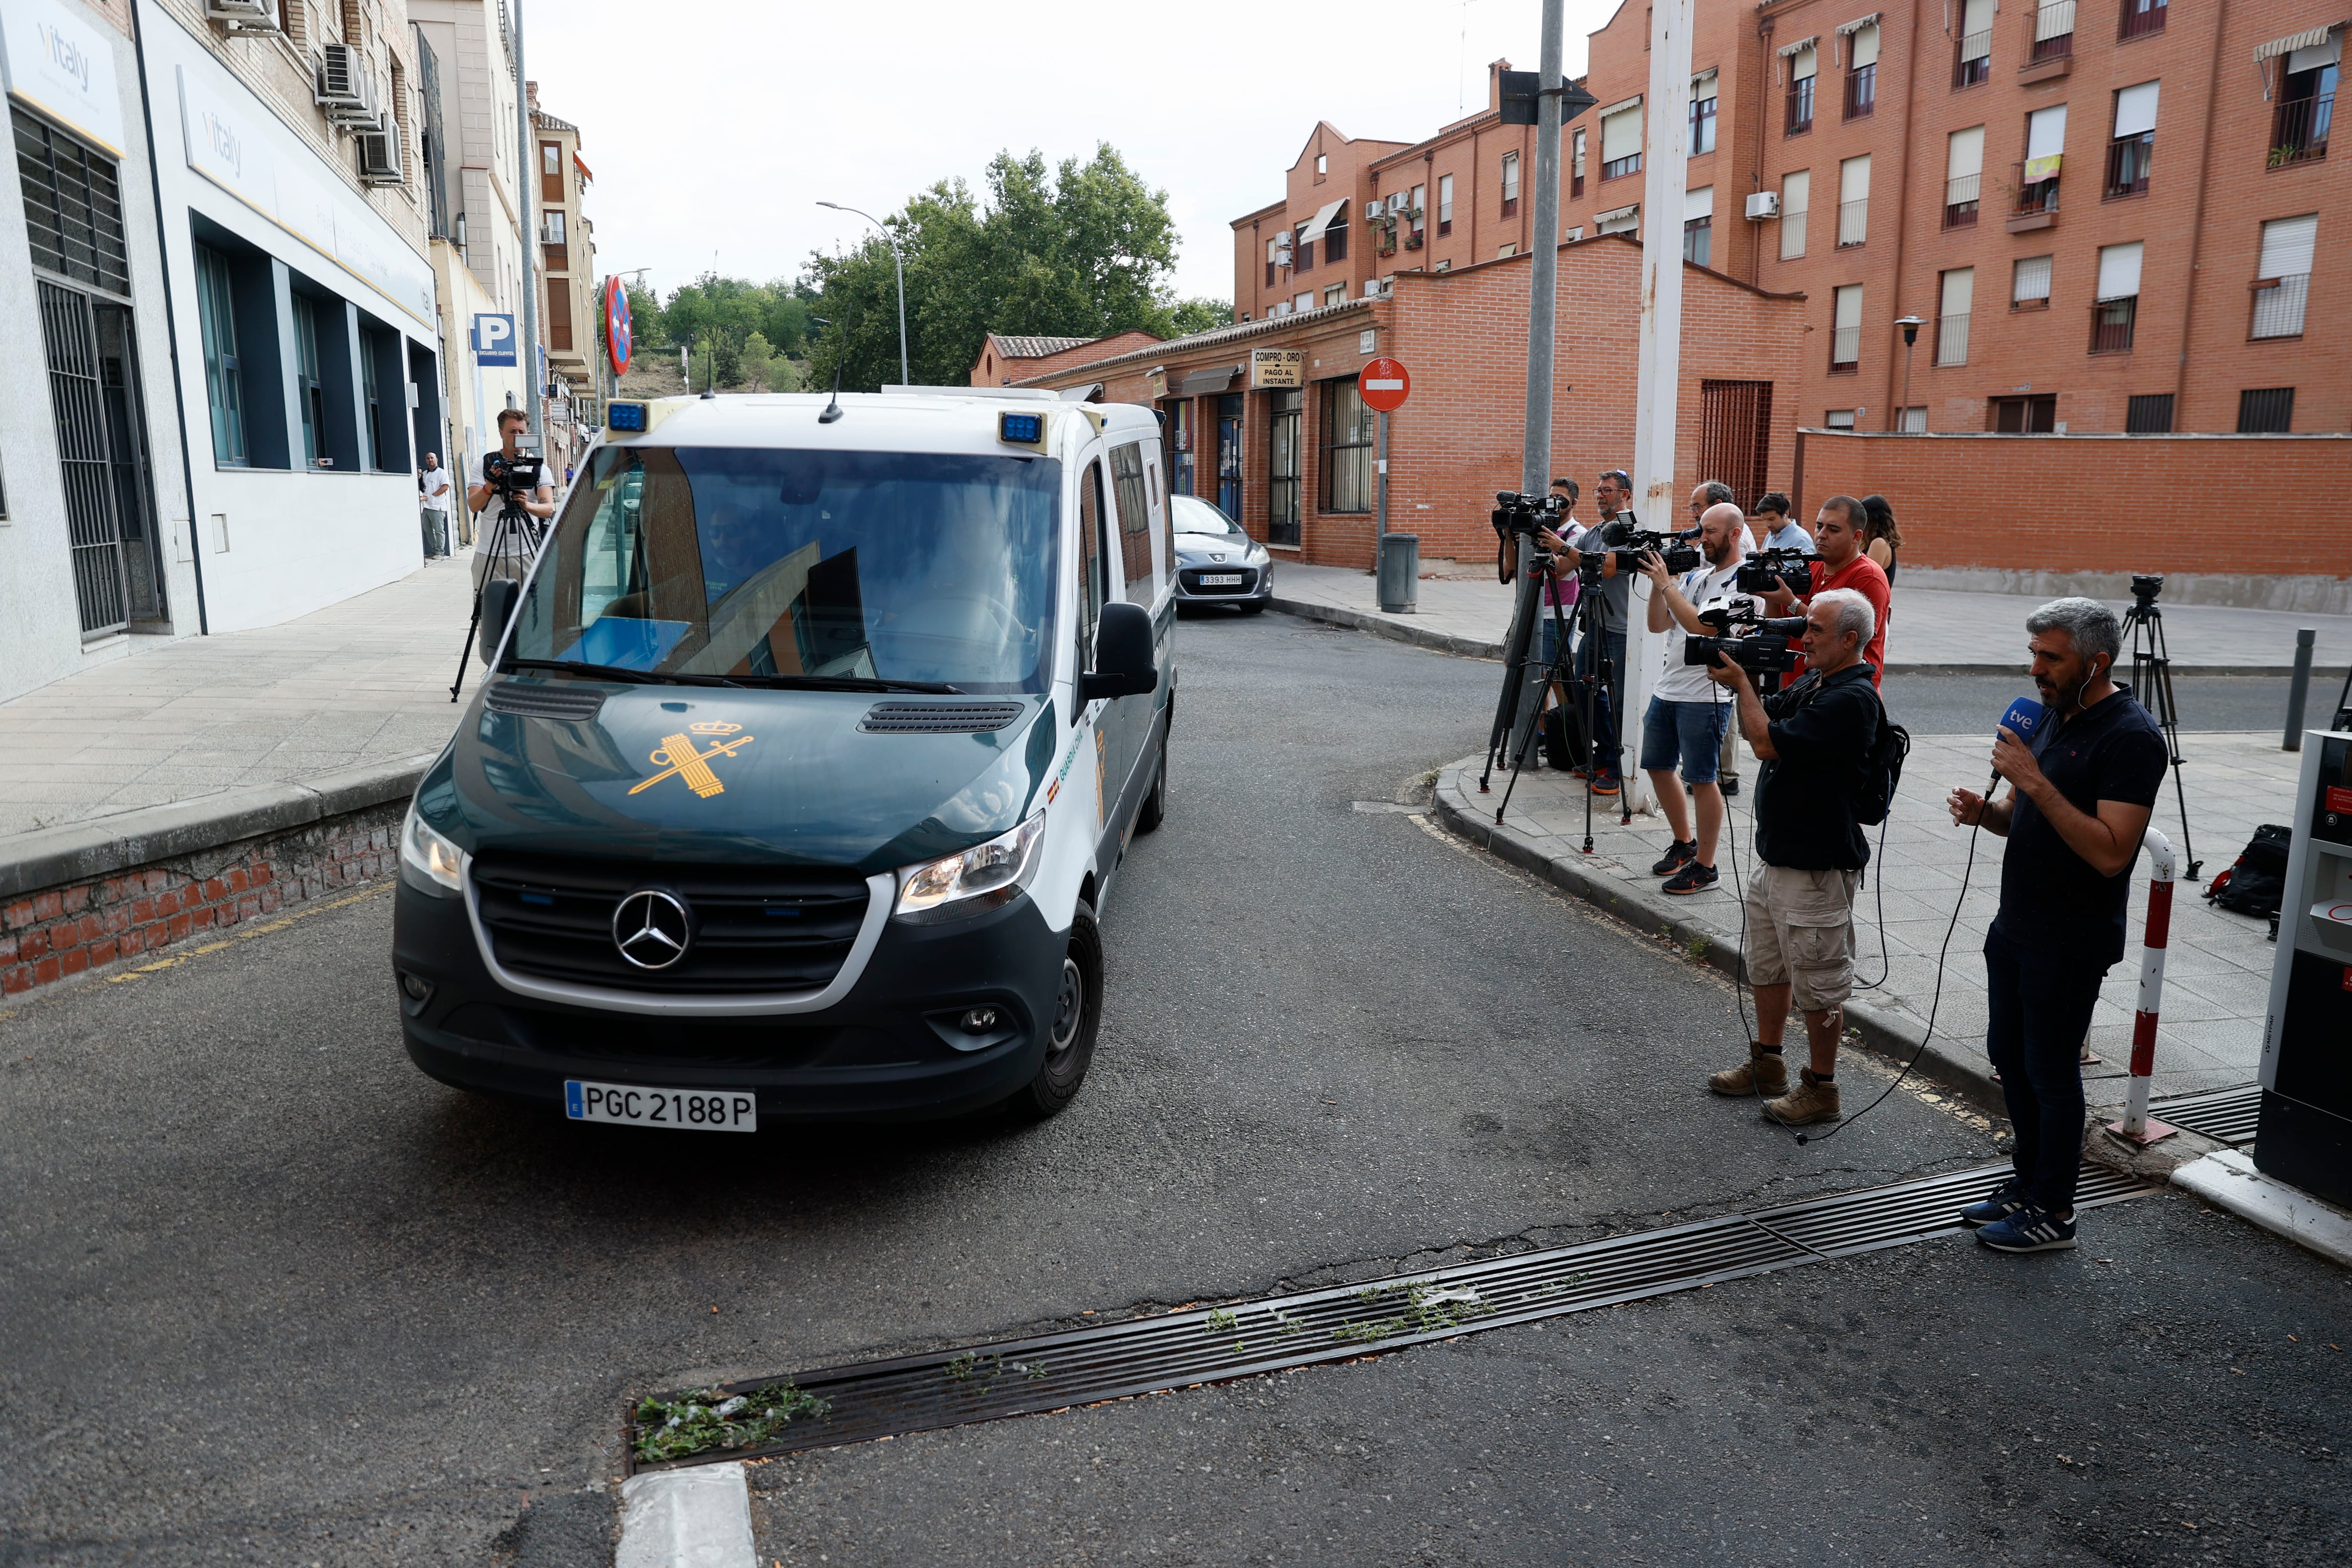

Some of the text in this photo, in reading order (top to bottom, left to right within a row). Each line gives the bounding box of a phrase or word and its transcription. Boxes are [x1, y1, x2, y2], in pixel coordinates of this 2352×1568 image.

[38, 21, 88, 93] vitaly
[202, 111, 240, 178] vitaly
[479, 317, 510, 349] P
[1256, 352, 1282, 361] COMPRO
[1287, 352, 1300, 361] ORO
[2010, 709, 2032, 729] tve
[1060, 745, 1076, 781] GUARDIA
